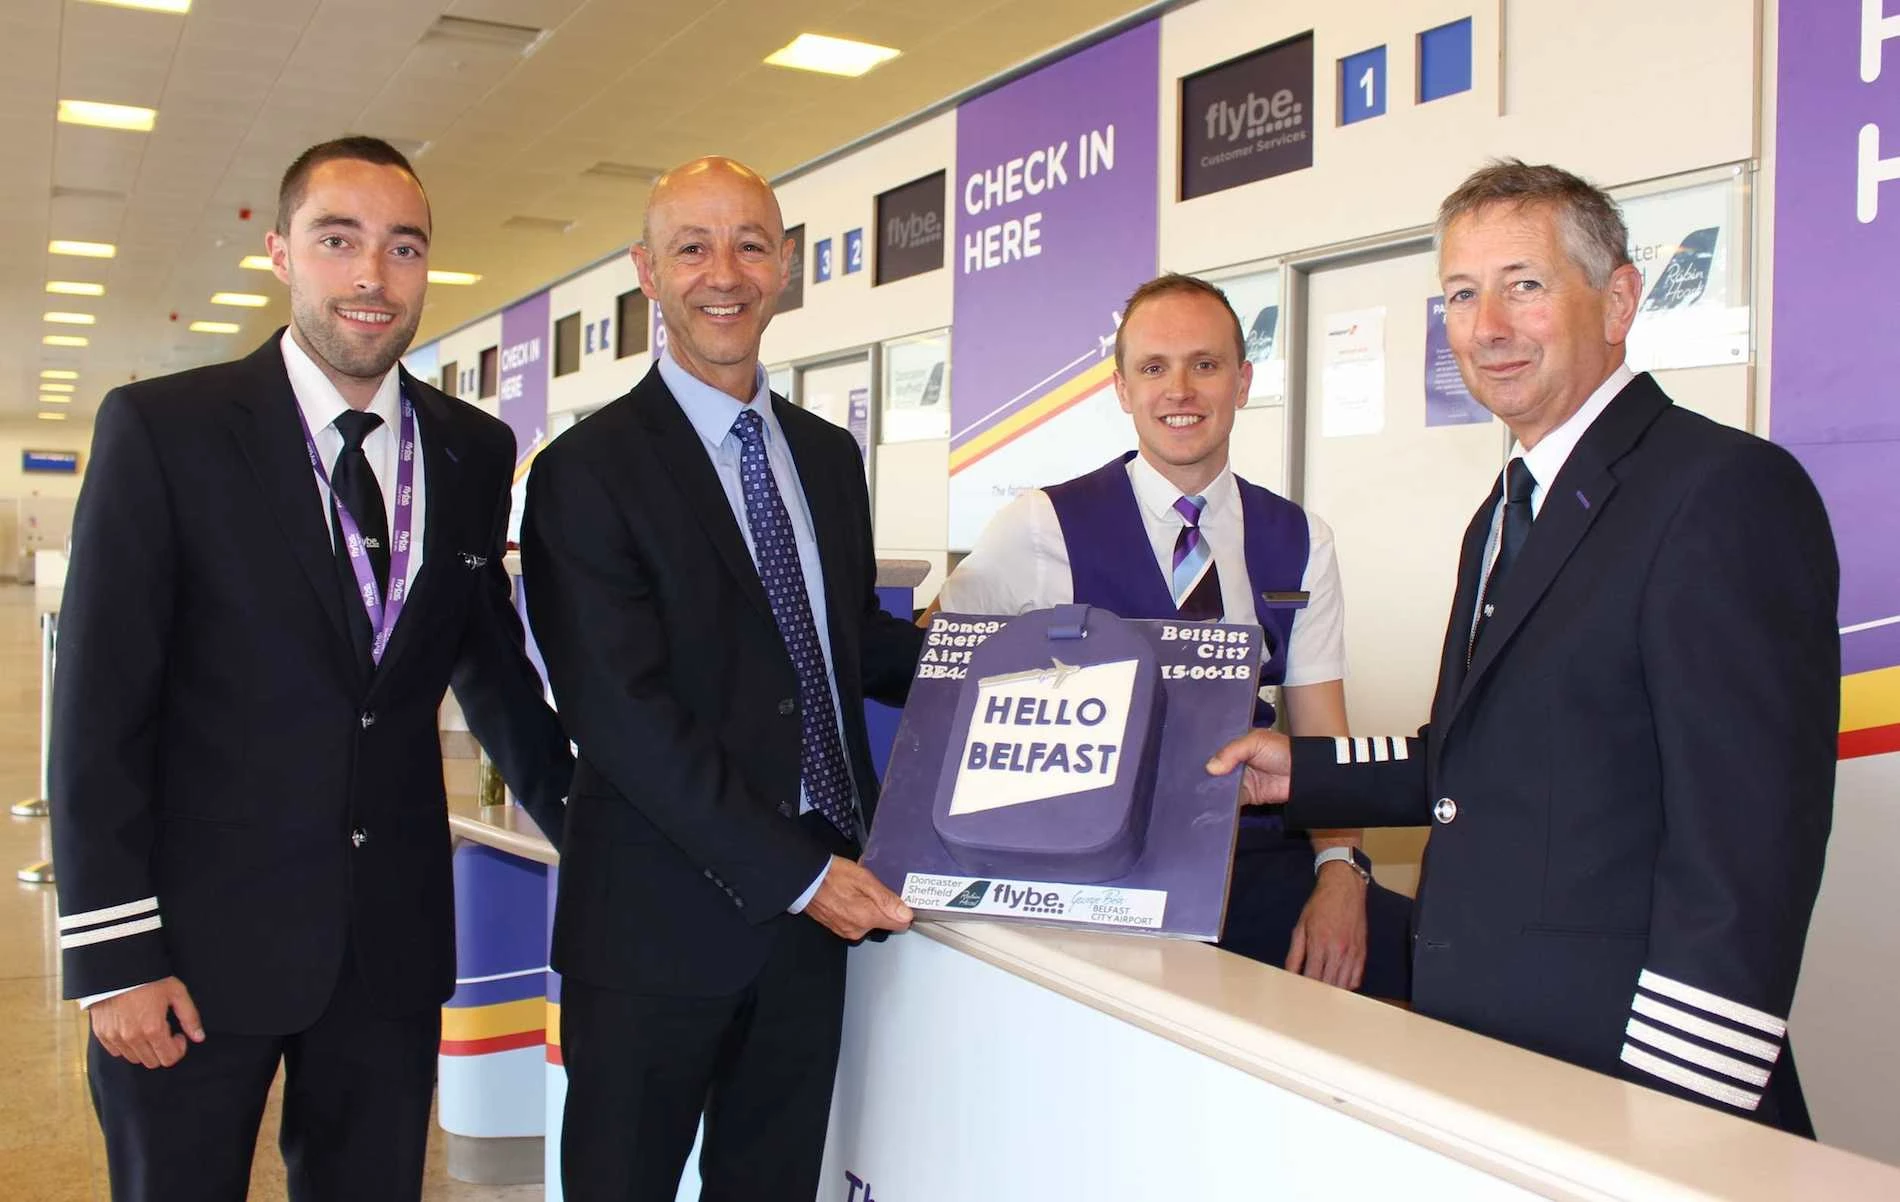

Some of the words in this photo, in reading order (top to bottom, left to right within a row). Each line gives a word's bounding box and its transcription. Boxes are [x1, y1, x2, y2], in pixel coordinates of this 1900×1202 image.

[1359, 66, 1374, 108] 1
[1200, 147, 1255, 167] Customer
[1256, 129, 1308, 153] Services
[964, 140, 1069, 216] CHECK
[1079, 124, 1115, 179] IN
[852, 239, 862, 266] 2
[964, 212, 1043, 274] HERE
[822, 249, 832, 275] 3
[502, 344, 530, 372] CHECK
[530, 337, 541, 363] IN
[501, 373, 524, 400] HERE
[931, 618, 1007, 634] Donca
[1161, 625, 1249, 644] Belfast
[1197, 643, 1250, 660] City
[984, 696, 1107, 727] HELLO
[967, 741, 1117, 774] BELFAST
[908, 884, 953, 897] Sheffield
[910, 875, 962, 888] Doncaster
[904, 895, 940, 907] Airport
[1092, 904, 1131, 915] BELFAST
[1090, 913, 1115, 922] CITY
[1114, 914, 1153, 926] AIRPORT
